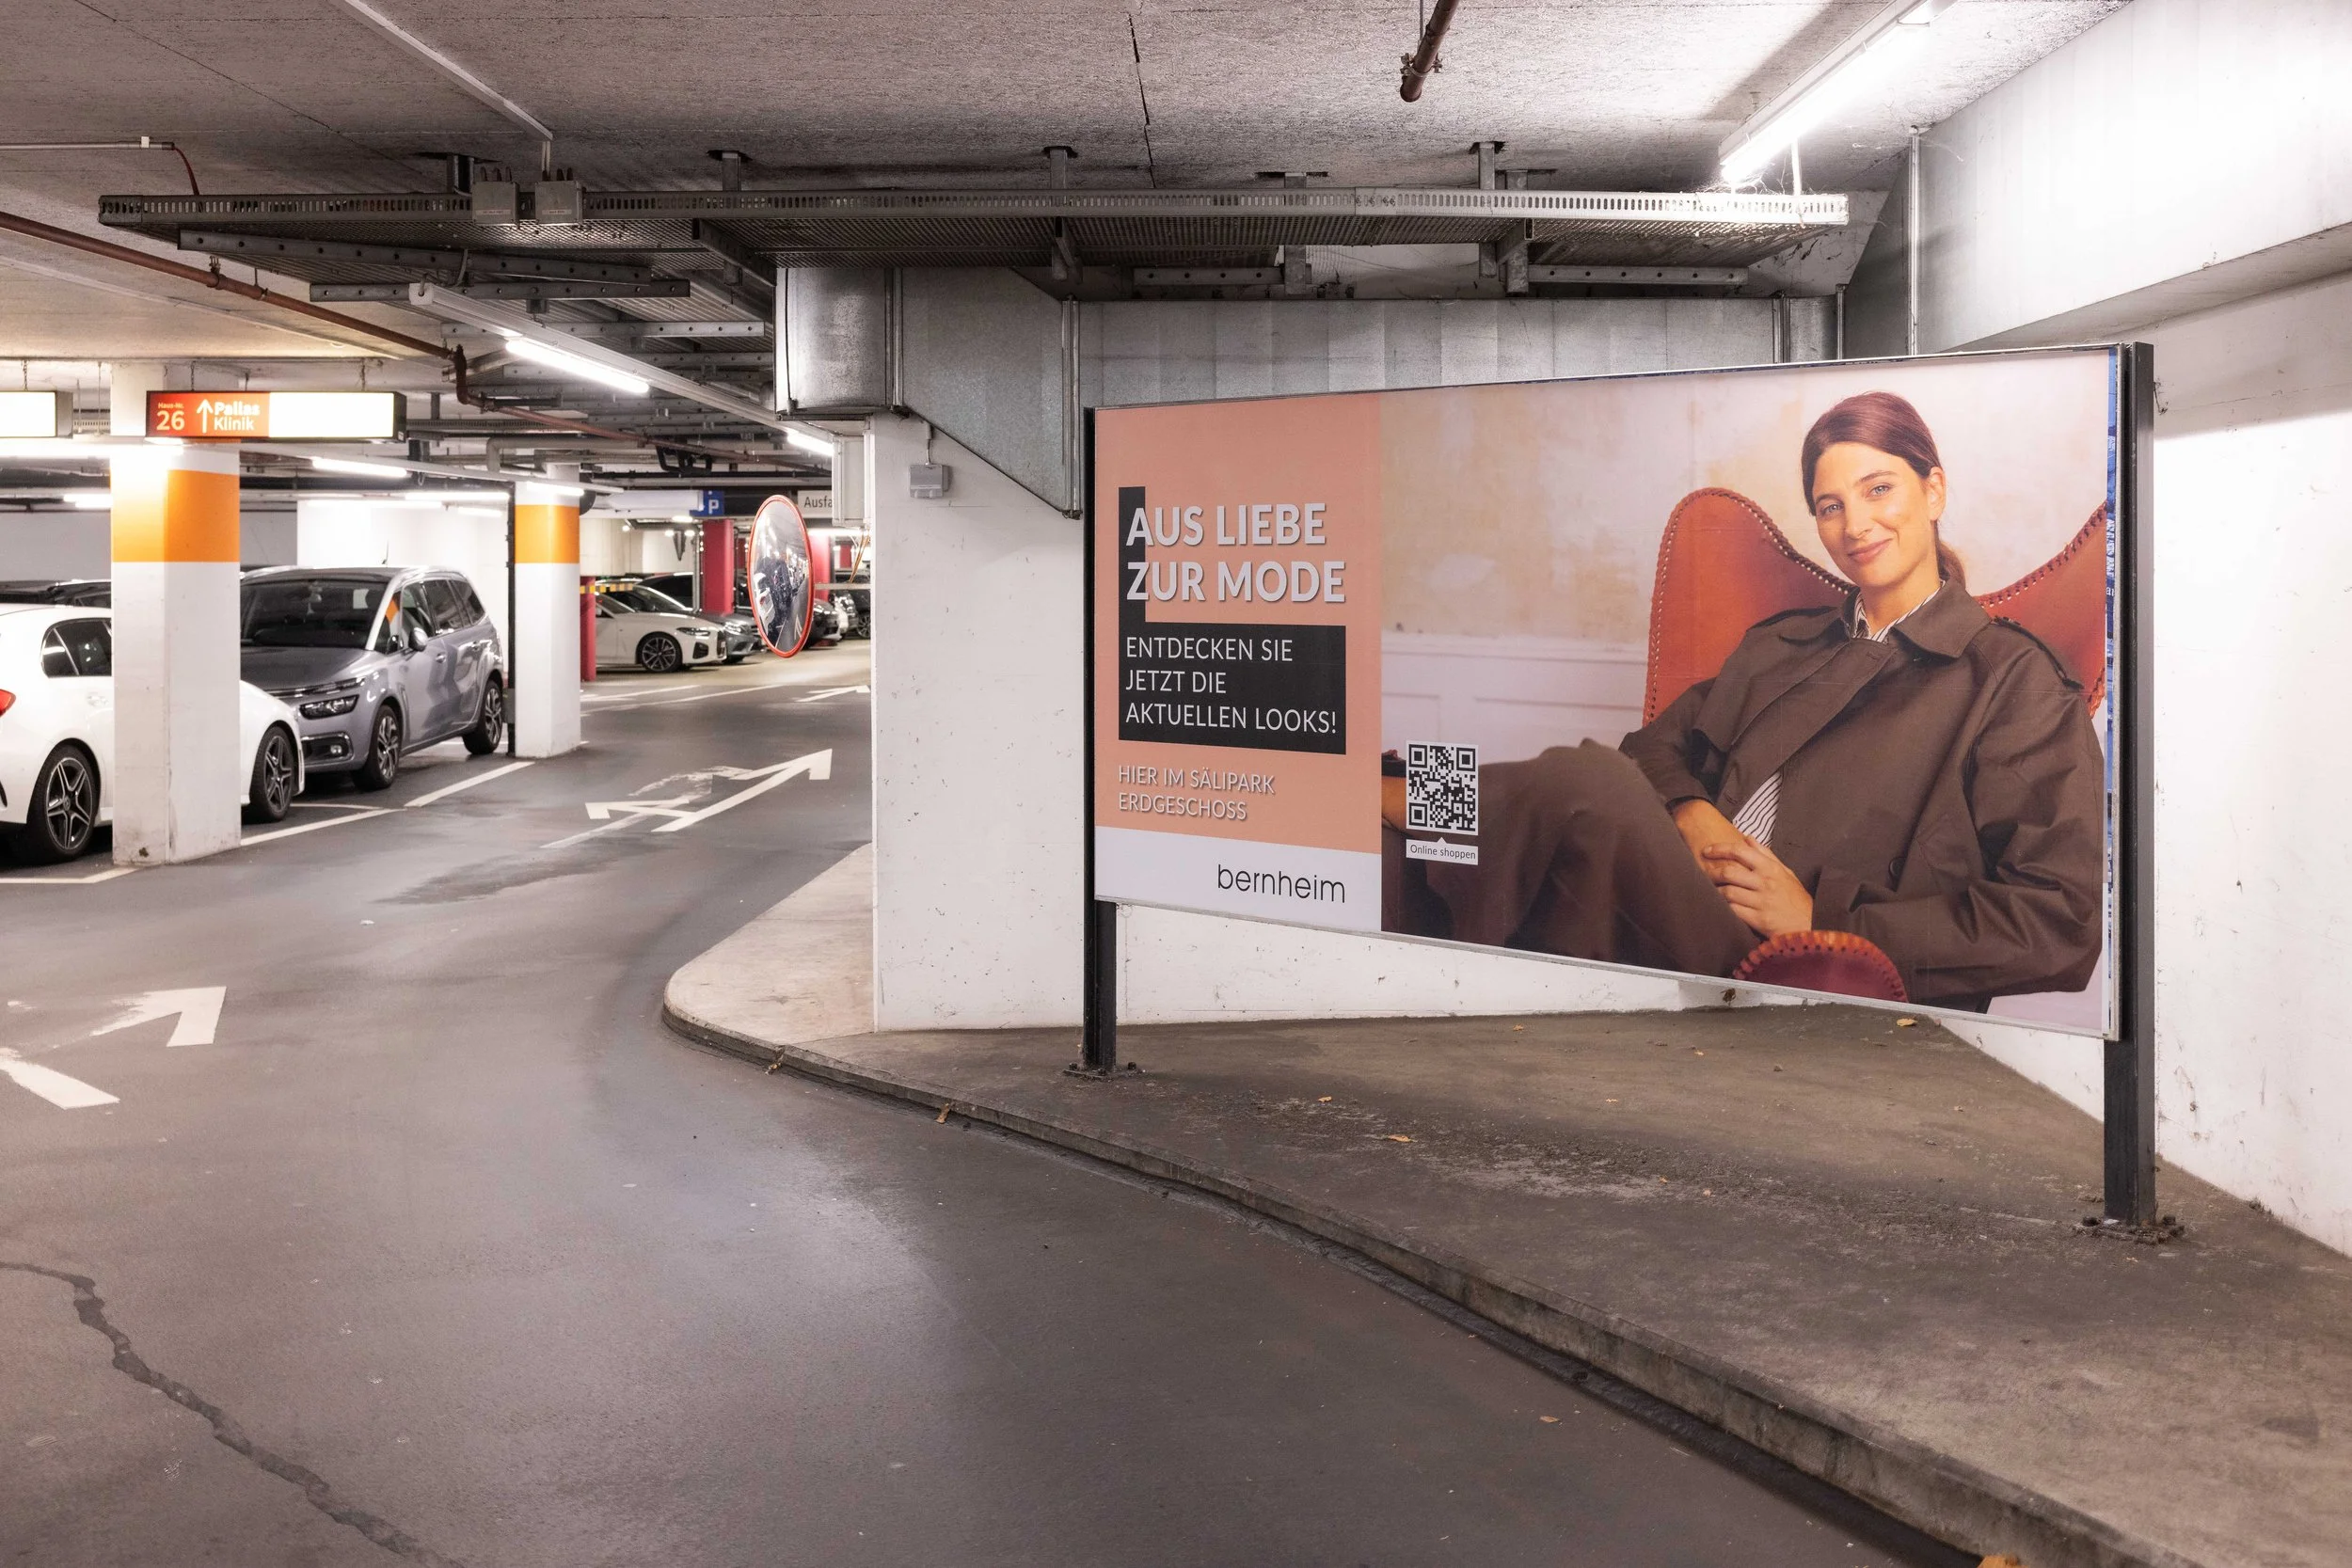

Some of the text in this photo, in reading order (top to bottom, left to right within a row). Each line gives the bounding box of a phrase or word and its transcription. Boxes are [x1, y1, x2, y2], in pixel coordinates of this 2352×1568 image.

[156, 410, 185, 431] 26
[215, 401, 261, 416] Pallas
[214, 417, 255, 431] Klinik
[707, 499, 720, 515] P
[1125, 502, 1327, 546] AUS LIEBE
[1126, 560, 1346, 603] ZUR MODE
[1126, 636, 1294, 662] ENTDECKEN SIE
[1125, 669, 1227, 694] JETZT DIE
[1125, 702, 1337, 734] AKTUELLEN LOOKS!
[1118, 765, 1277, 795] HIER IM SÄLIPARK
[1118, 792, 1248, 821] ERDGESCHOSS
[1409, 844, 1476, 860] Online shoppen
[1217, 863, 1345, 903] bernheim
